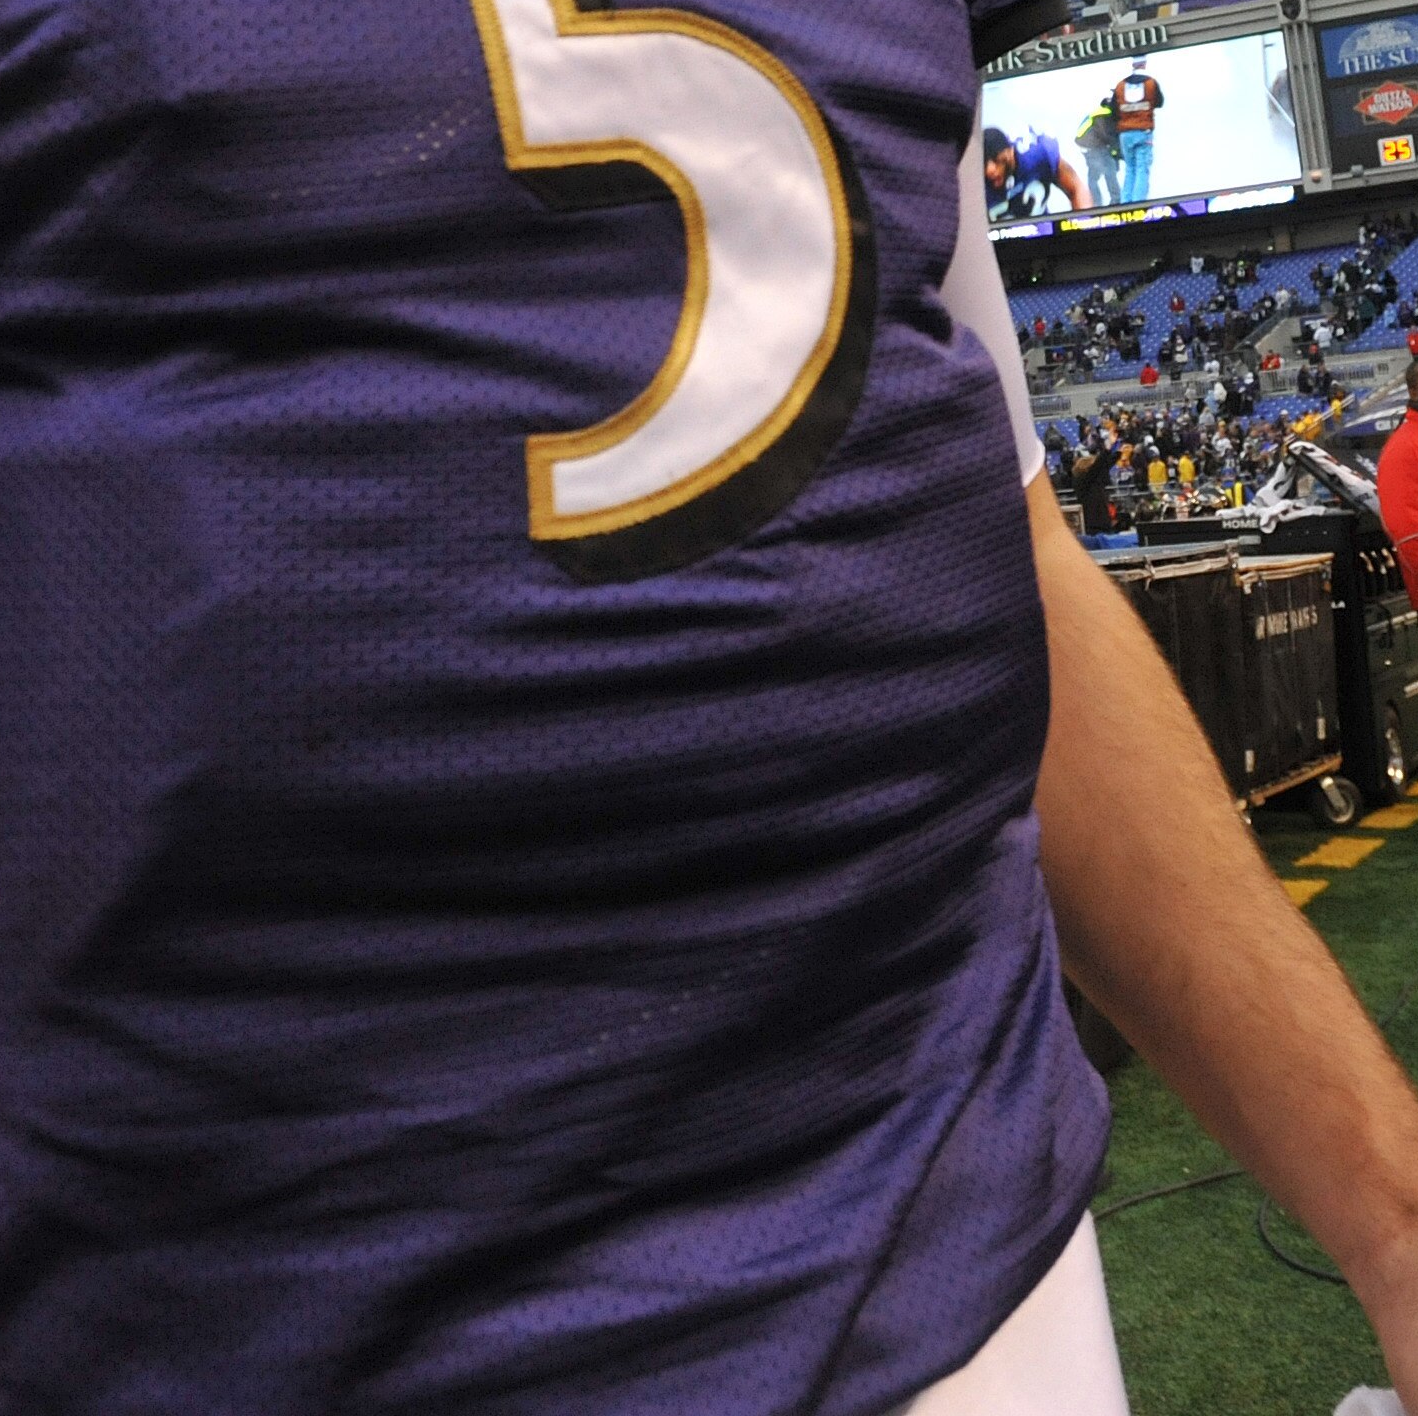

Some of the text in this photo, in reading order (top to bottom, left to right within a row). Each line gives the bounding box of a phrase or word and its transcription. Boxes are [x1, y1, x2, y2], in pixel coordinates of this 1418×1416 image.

[1035, 25, 1168, 64] Stadium
[1344, 53, 1385, 75] THE
[1383, 138, 1412, 162] 25
[1222, 518, 1259, 529] HOME
